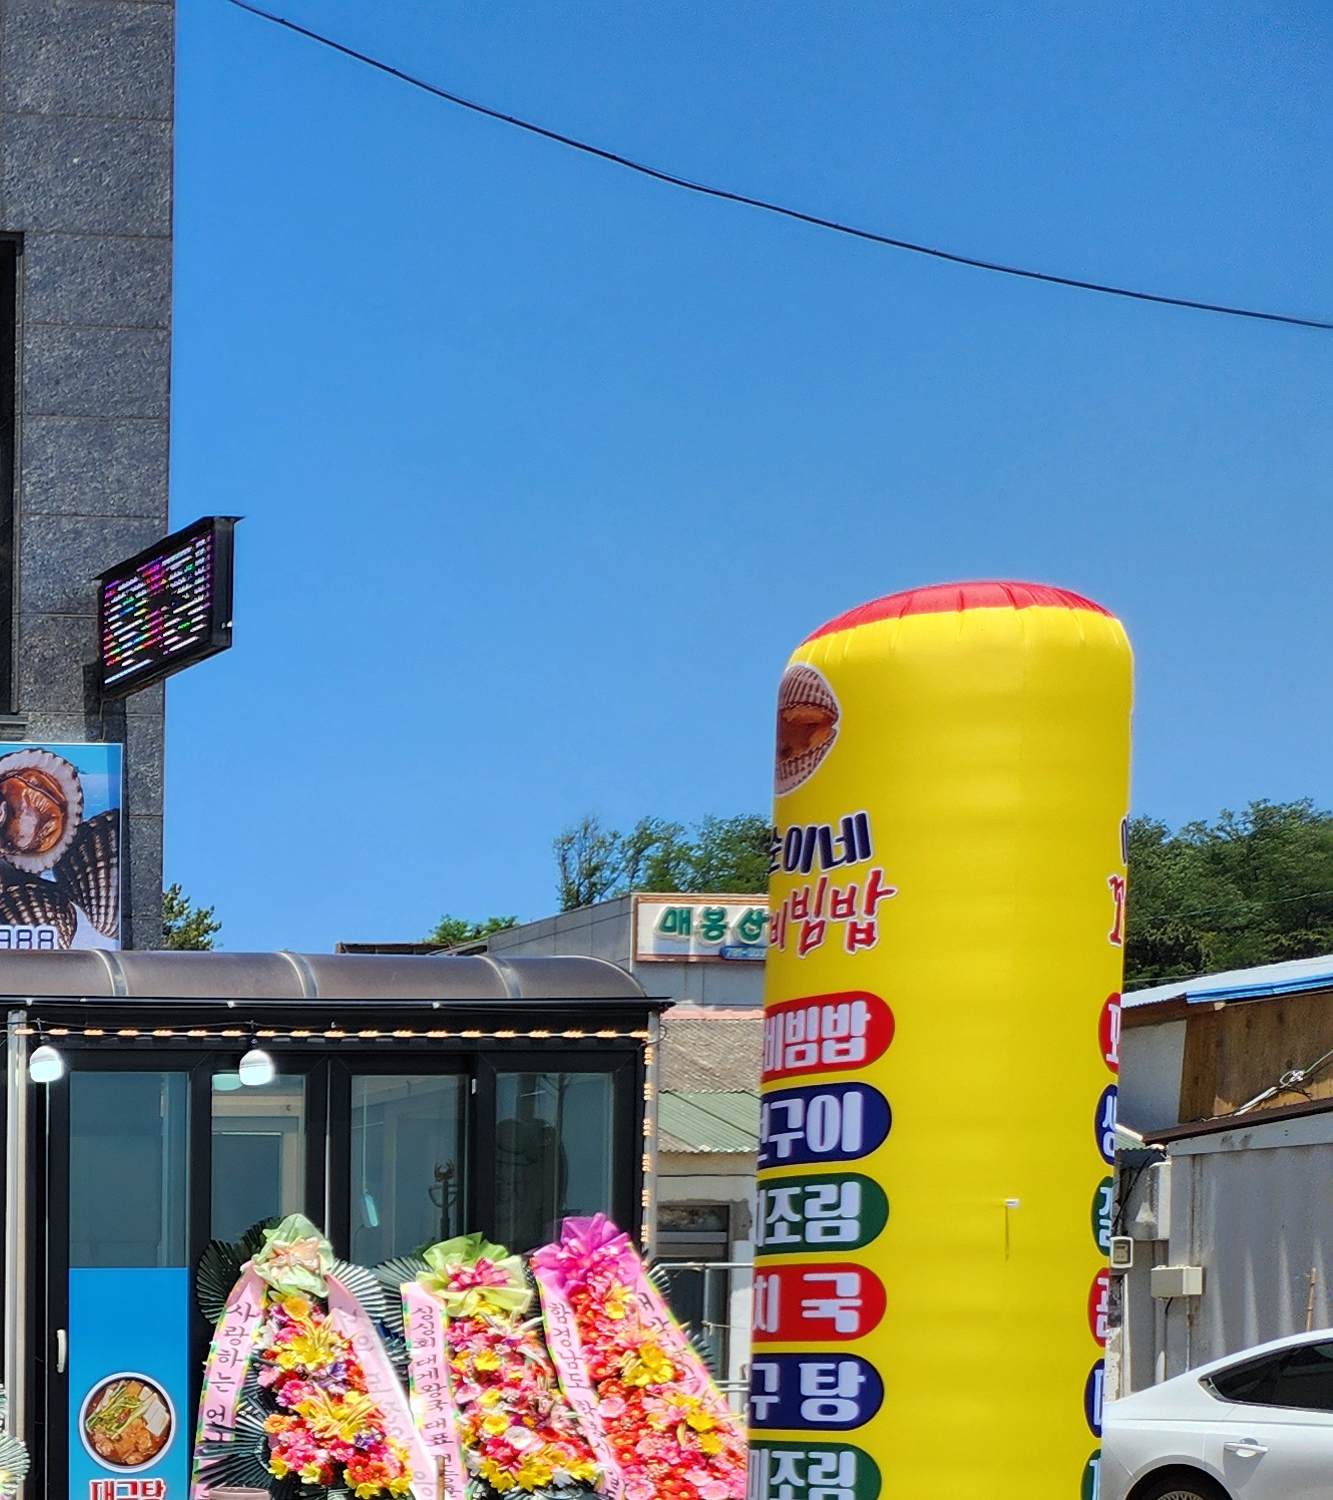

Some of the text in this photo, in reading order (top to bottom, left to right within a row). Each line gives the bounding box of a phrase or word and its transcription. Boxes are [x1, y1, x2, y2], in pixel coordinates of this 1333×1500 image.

[758, 1091, 863, 1162] 구이
[749, 1181, 862, 1248] 조림
[207, 1302, 257, 1393] 사랑하는
